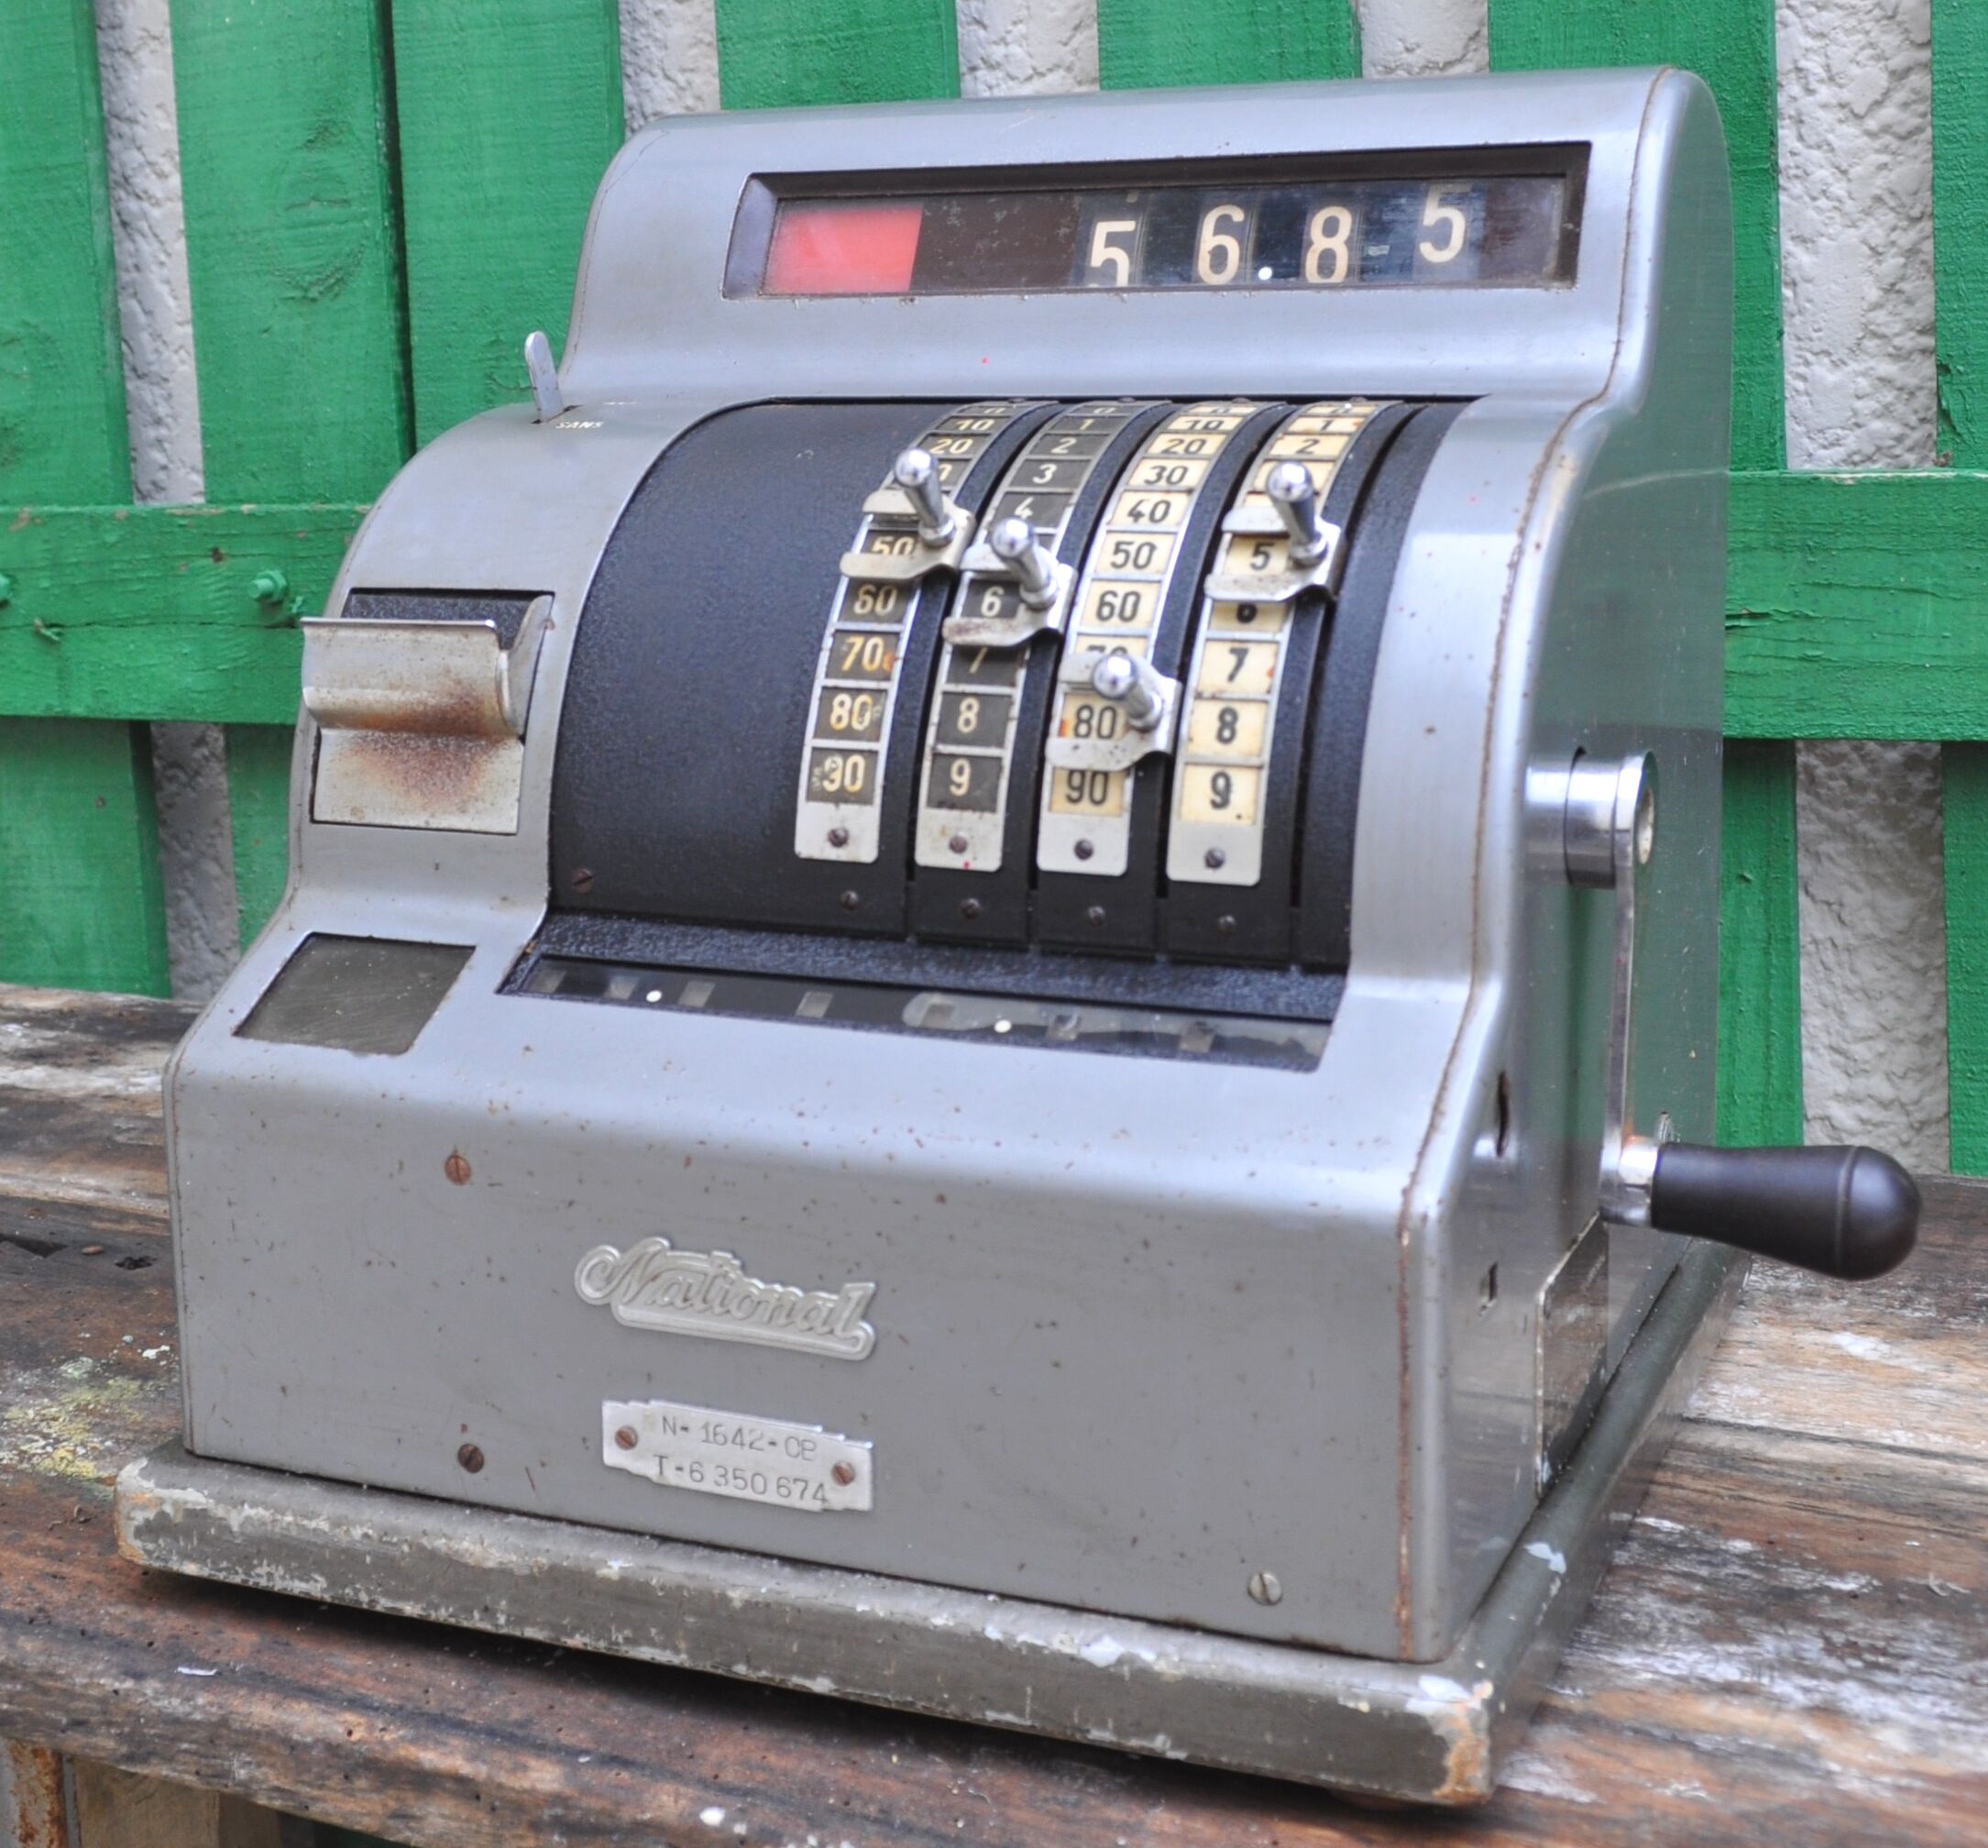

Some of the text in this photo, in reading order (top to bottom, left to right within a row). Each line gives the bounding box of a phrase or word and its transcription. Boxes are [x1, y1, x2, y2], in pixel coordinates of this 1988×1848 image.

[1090, 219, 1137, 287] 5
[1305, 205, 1353, 284] 8
[1420, 184, 1472, 263] 5
[555, 421, 603, 429] SANS
[955, 418, 995, 431] 10
[1079, 418, 1095, 431] 1
[929, 438, 974, 455] 20
[1050, 437, 1078, 454] 2
[1159, 437, 1207, 456] 20
[1296, 437, 1321, 455] 2
[1032, 463, 1059, 485] 3
[1143, 465, 1190, 485] 30
[1014, 496, 1035, 520] 4
[1126, 499, 1172, 523] 40
[1110, 540, 1157, 570] 50
[1249, 542, 1277, 571] 5
[980, 585, 1005, 618] 6
[1094, 589, 1142, 622] 60
[841, 636, 884, 672] 70
[1228, 646, 1250, 683] 7
[829, 692, 873, 732] 80
[956, 697, 980, 733] 8
[1073, 704, 1117, 740] 80
[1216, 706, 1239, 745] 8
[950, 757, 972, 797] 9
[1066, 769, 1109, 806] 90
[1210, 770, 1233, 809] 9
[576, 1238, 875, 1352] National
